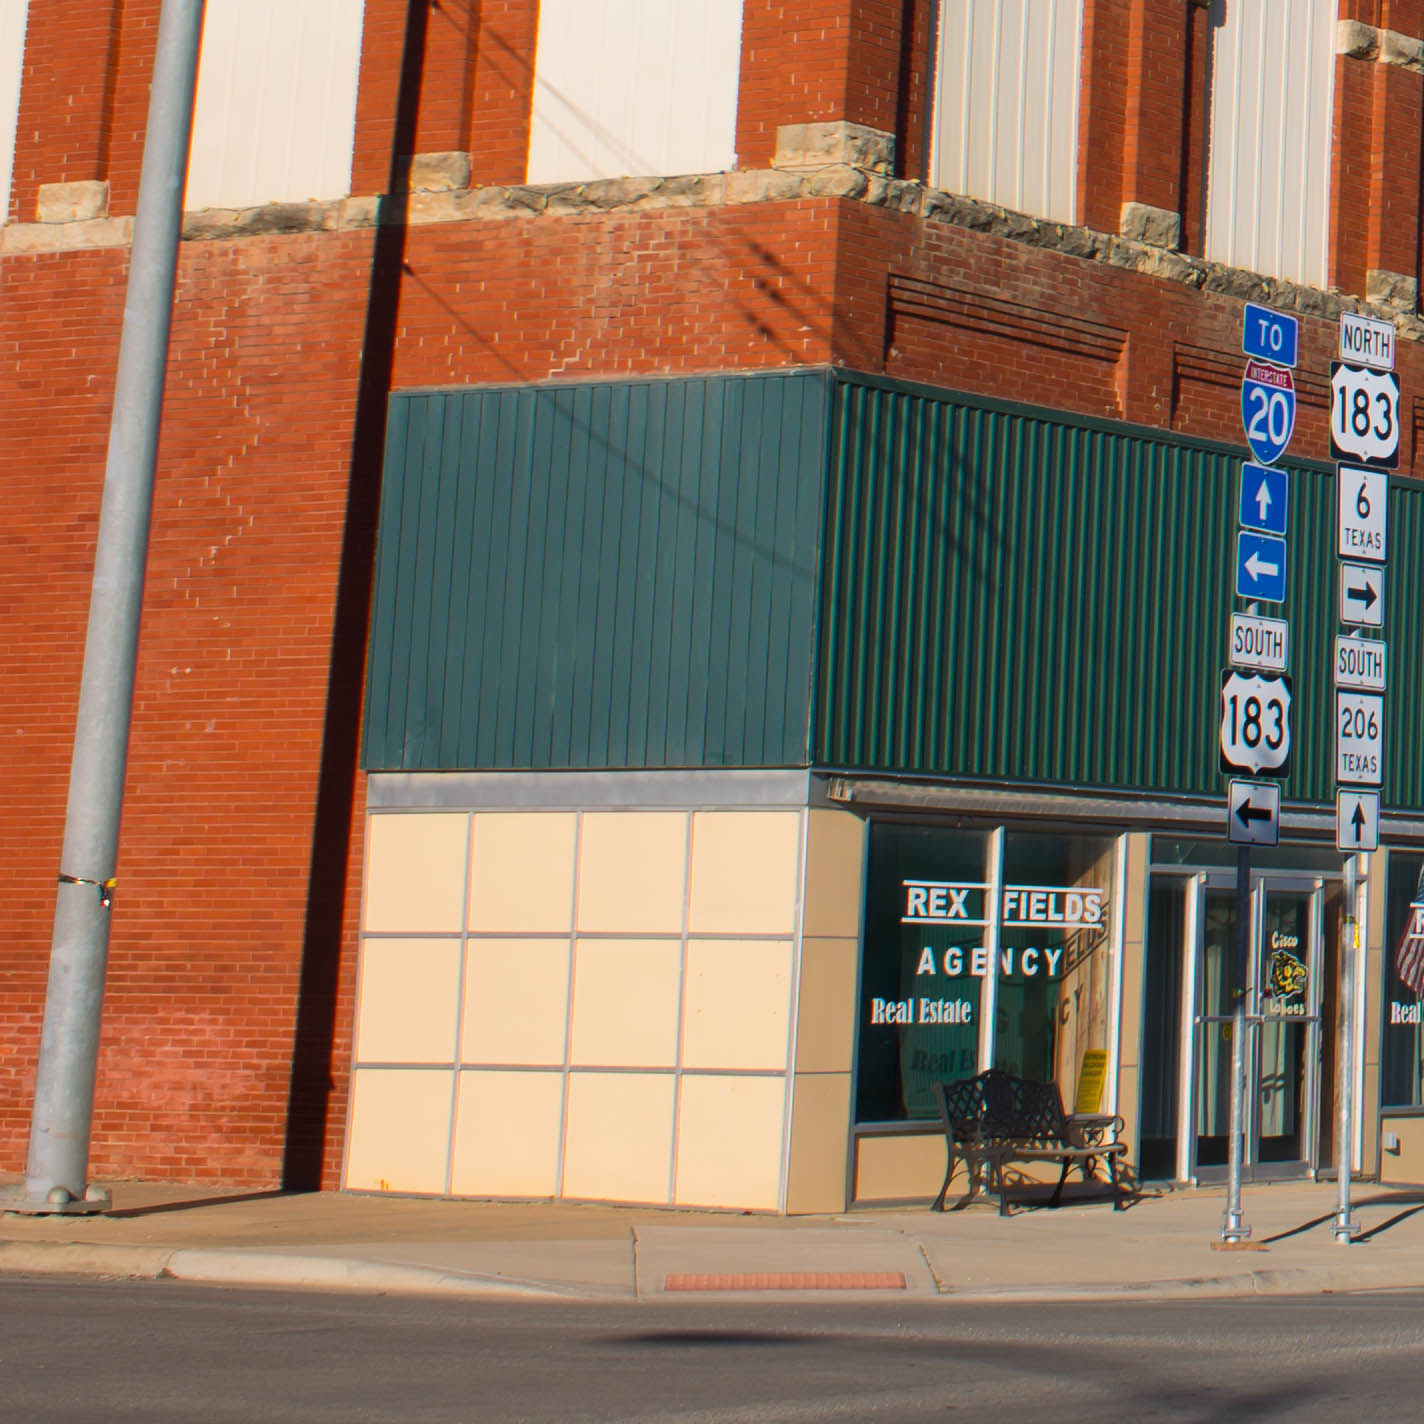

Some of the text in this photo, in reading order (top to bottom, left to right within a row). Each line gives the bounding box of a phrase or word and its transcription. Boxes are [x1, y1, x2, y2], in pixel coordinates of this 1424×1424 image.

[1258, 318, 1282, 352] TO
[1343, 326, 1391, 361] NORTH
[1250, 365, 1288, 387] INTERSTATE
[1248, 391, 1288, 446] 20
[1338, 385, 1393, 440] 183
[1356, 482, 1371, 520] 6
[1344, 527, 1382, 551] TEXAS
[1234, 626, 1283, 660] SOUTH
[1339, 647, 1382, 680] SOUTH
[1230, 694, 1284, 748] 183
[1341, 707, 1378, 740] 206
[1341, 752, 1377, 775] TEXAS
[907, 887, 1101, 923] REX FIELDS
[1271, 930, 1299, 949] Cisco
[916, 946, 1063, 976] AGENCY
[871, 997, 972, 1024] Real Estate
[1390, 1001, 1422, 1024] Real
